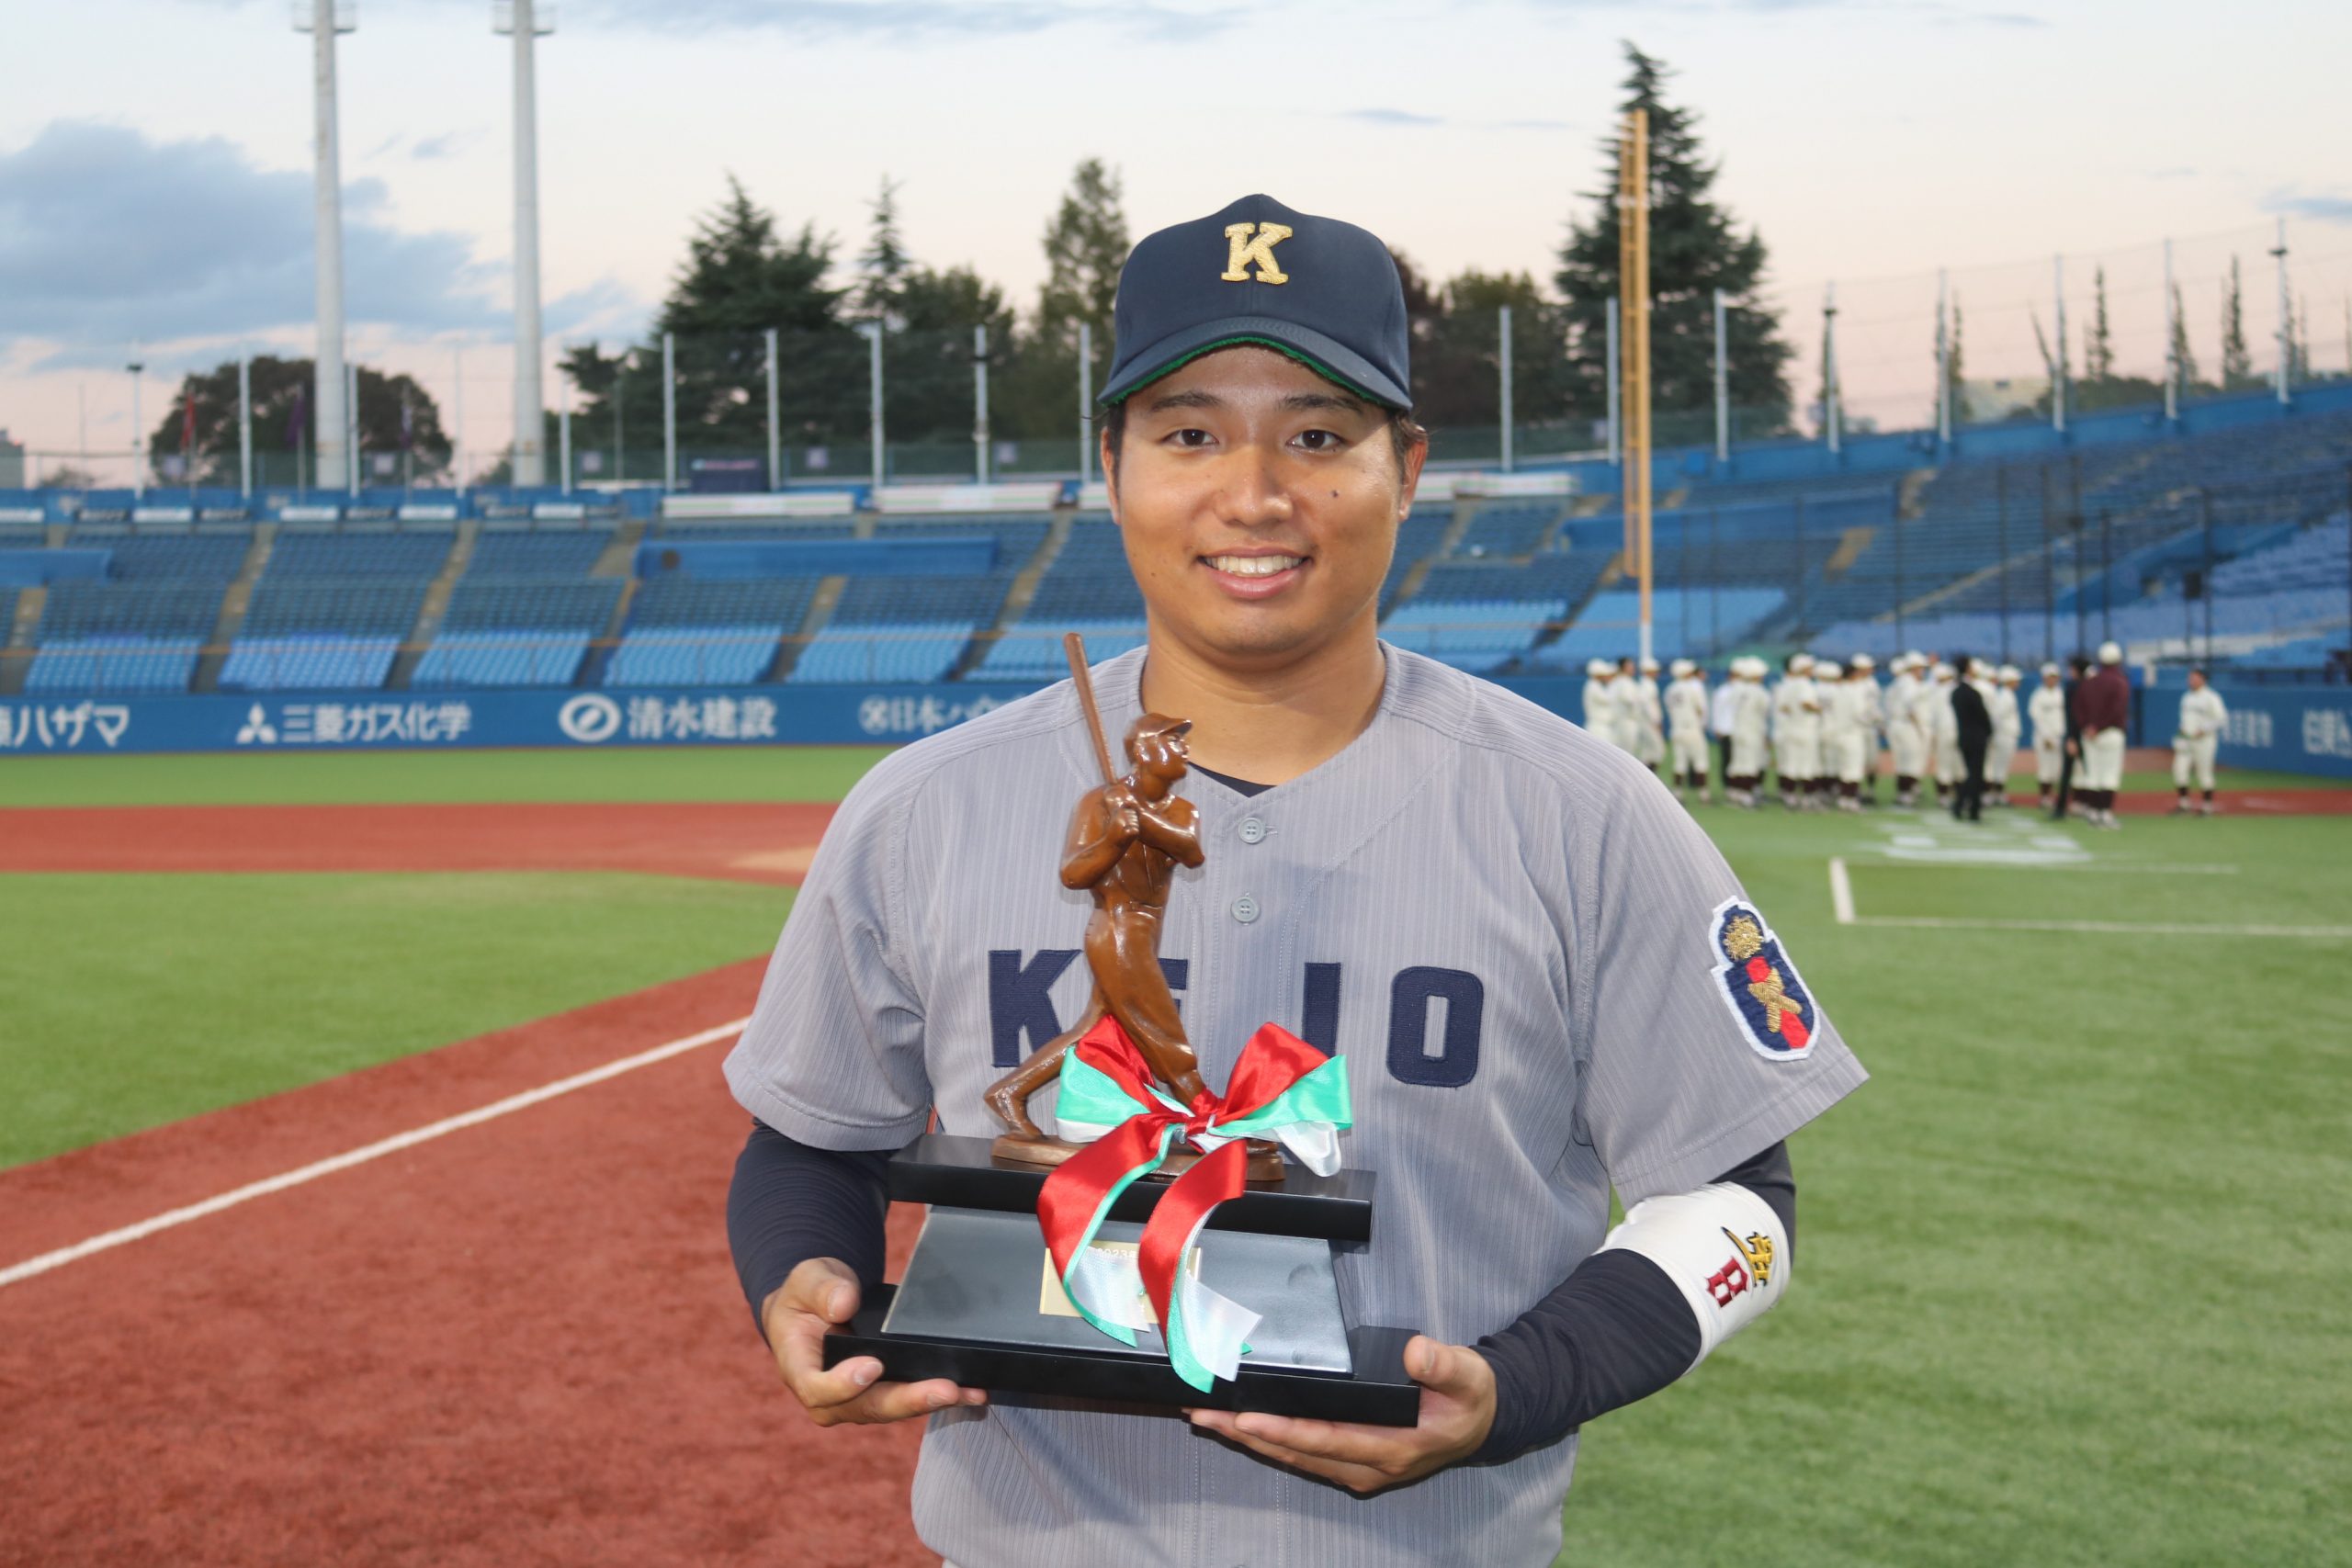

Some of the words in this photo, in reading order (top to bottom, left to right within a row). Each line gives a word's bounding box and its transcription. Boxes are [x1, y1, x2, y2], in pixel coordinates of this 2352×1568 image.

[1220, 221, 1294, 286] K
[281, 701, 472, 743] 三菱ガス化学
[628, 696, 777, 740] 清水建設
[988, 949, 1485, 1089] KIO
